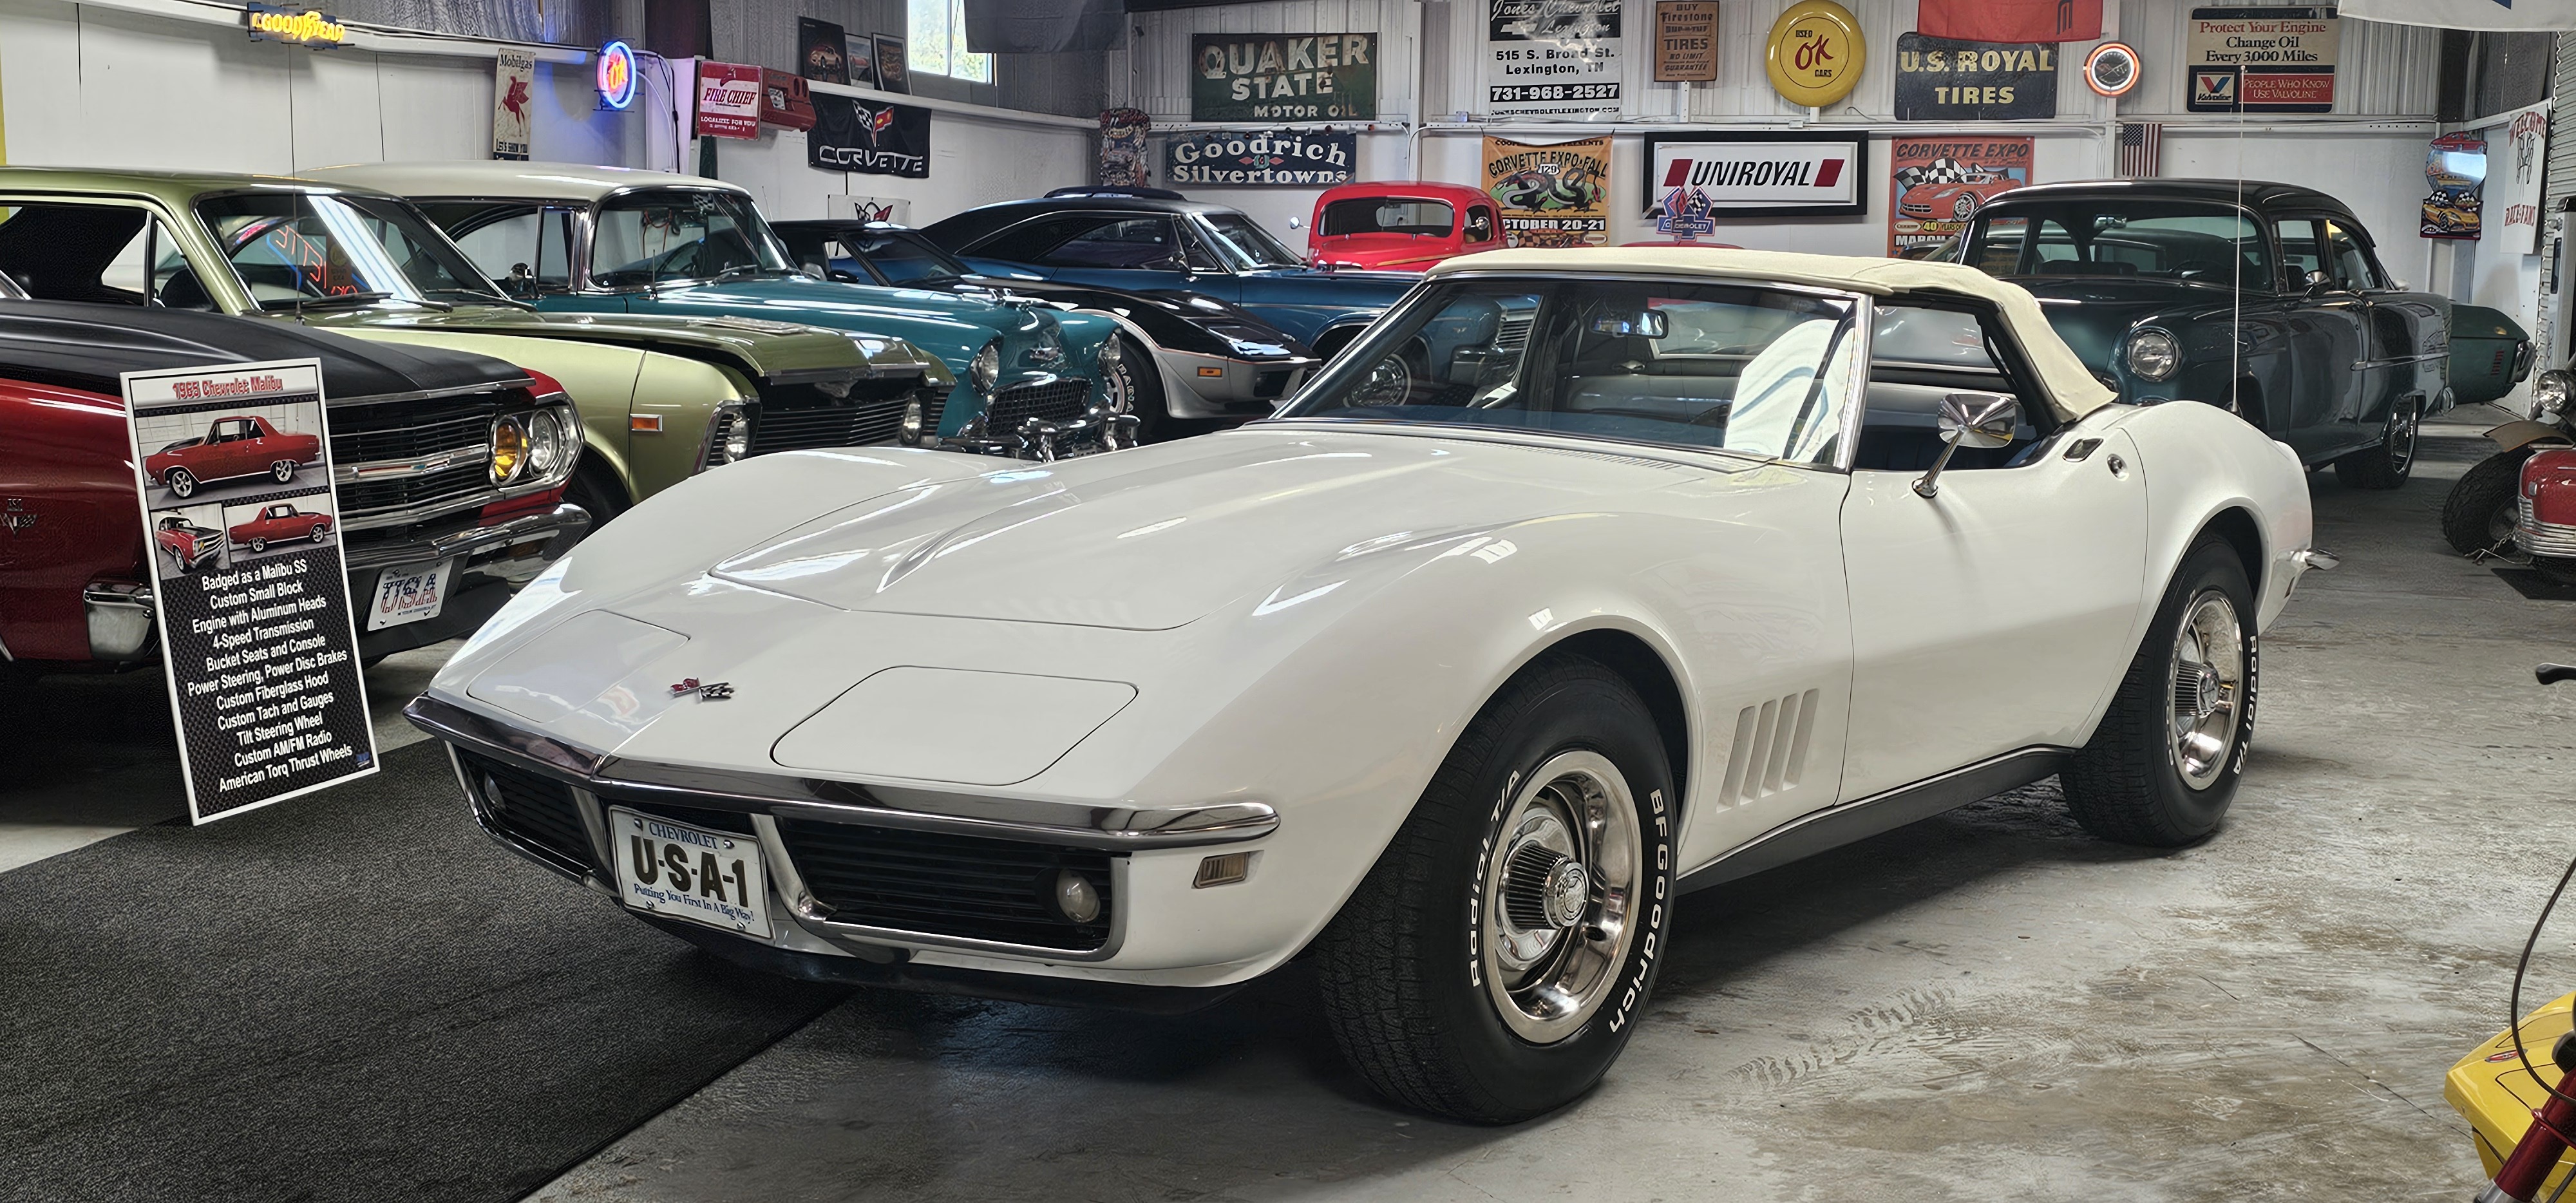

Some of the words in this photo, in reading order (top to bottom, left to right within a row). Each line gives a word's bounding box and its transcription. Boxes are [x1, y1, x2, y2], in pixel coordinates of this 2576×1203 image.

[1660, 12, 1713, 22] Firestone
[2200, 21, 2244, 33] Protect
[2248, 21, 2277, 33] Your
[2280, 21, 2326, 34] Engine
[1199, 34, 1369, 79] QUAKER
[1496, 50, 1519, 61] 515
[1526, 50, 1539, 59] S.
[1546, 48, 1588, 59] Broad
[1595, 48, 1615, 57] St.
[1664, 39, 1708, 50] TIRES
[1795, 34, 1833, 70] OK
[2226, 37, 2275, 50] Change
[2278, 36, 2299, 48] Oil
[499, 53, 533, 72] Mobilgas
[1506, 64, 1580, 75] Lexington,
[1586, 62, 1604, 72] TN
[1900, 50, 1949, 72] U.S.
[1958, 50, 2054, 71] ROYAL
[2206, 50, 2241, 64] Every
[2243, 51, 2279, 63] 3,000
[2282, 50, 2318, 62] Miles
[704, 88, 727, 102] FIRE
[727, 90, 757, 105] CHIEF
[1232, 71, 1333, 101] STATE
[1492, 85, 1618, 100] 731-968-2527
[1935, 86, 2014, 104] TIRES
[2244, 79, 2276, 88] PEOPLE
[2278, 79, 2300, 88] WHO
[2302, 79, 2330, 88] KNOW
[2253, 90, 2270, 99] USE
[1255, 105, 1318, 117] MOTOR
[1328, 104, 1358, 117] OIL
[819, 145, 923, 171] CORVETTE
[1175, 134, 1347, 166] Goodrich
[1897, 143, 1983, 158] CORVETTE
[1985, 143, 2029, 158] EXPO
[1173, 165, 1347, 184] Silvertowns
[1488, 151, 1546, 177] CORVETTE
[1551, 151, 1578, 167] EXPO
[1582, 156, 1608, 179] FALL
[1691, 161, 1811, 185] UNIROYAL
[1503, 219, 1558, 230] CTOBER
[1562, 220, 1605, 230] 20-21
[173, 381, 201, 399] 1965
[202, 377, 250, 397] Chevrolet
[250, 374, 283, 393] Malibu
[202, 569, 239, 591] Badged
[242, 573, 252, 583] as
[255, 569, 261, 581] a
[261, 564, 293, 580] Malibu
[294, 559, 307, 573] SS
[211, 592, 247, 609] Custom
[249, 584, 276, 602] Small
[278, 580, 303, 596] Block
[381, 573, 437, 614] USA
[193, 616, 227, 634] Engine
[229, 610, 249, 626] with
[251, 602, 297, 623] Aluminum
[298, 595, 327, 612] Heads
[213, 629, 252, 650] 4-Speed
[253, 618, 314, 641] Transmission
[206, 654, 240, 672] Bucket
[242, 647, 269, 663] Seats
[270, 643, 288, 658] and
[289, 634, 326, 653] Console
[187, 679, 219, 697] Power
[221, 670, 264, 689] Steering,
[265, 662, 293, 677] Power
[295, 656, 316, 672] Disc
[316, 649, 347, 665] Brakes
[2246, 636, 2259, 730] Radial
[216, 692, 254, 710] Custom
[255, 678, 303, 702] Fiberglass
[305, 670, 328, 689] Hood
[218, 712, 256, 730] Custom
[256, 703, 279, 720] Tach
[281, 697, 299, 713] and
[299, 691, 334, 710] Gauges
[236, 730, 253, 746] Tilt
[255, 721, 294, 742] Steering
[294, 711, 323, 731] Wheel
[234, 748, 272, 767] Custom
[273, 737, 305, 754] AM/FM
[306, 730, 332, 748] Radio
[2233, 740, 2250, 775] T/A
[219, 768, 265, 793] American
[265, 761, 290, 777] Torq
[289, 753, 319, 773] Thrust
[319, 744, 353, 764] Wheels
[649, 822, 717, 849] CHEVROLET
[634, 883, 665, 904] Putting
[666, 890, 681, 902] You
[683, 895, 701, 907] First
[702, 900, 712, 911] In
[714, 903, 720, 913] A
[720, 904, 736, 921] Big
[734, 907, 755, 924] Way!
[1470, 838, 1490, 987] Radial
[1609, 788, 1669, 1032] BFGoodrich
